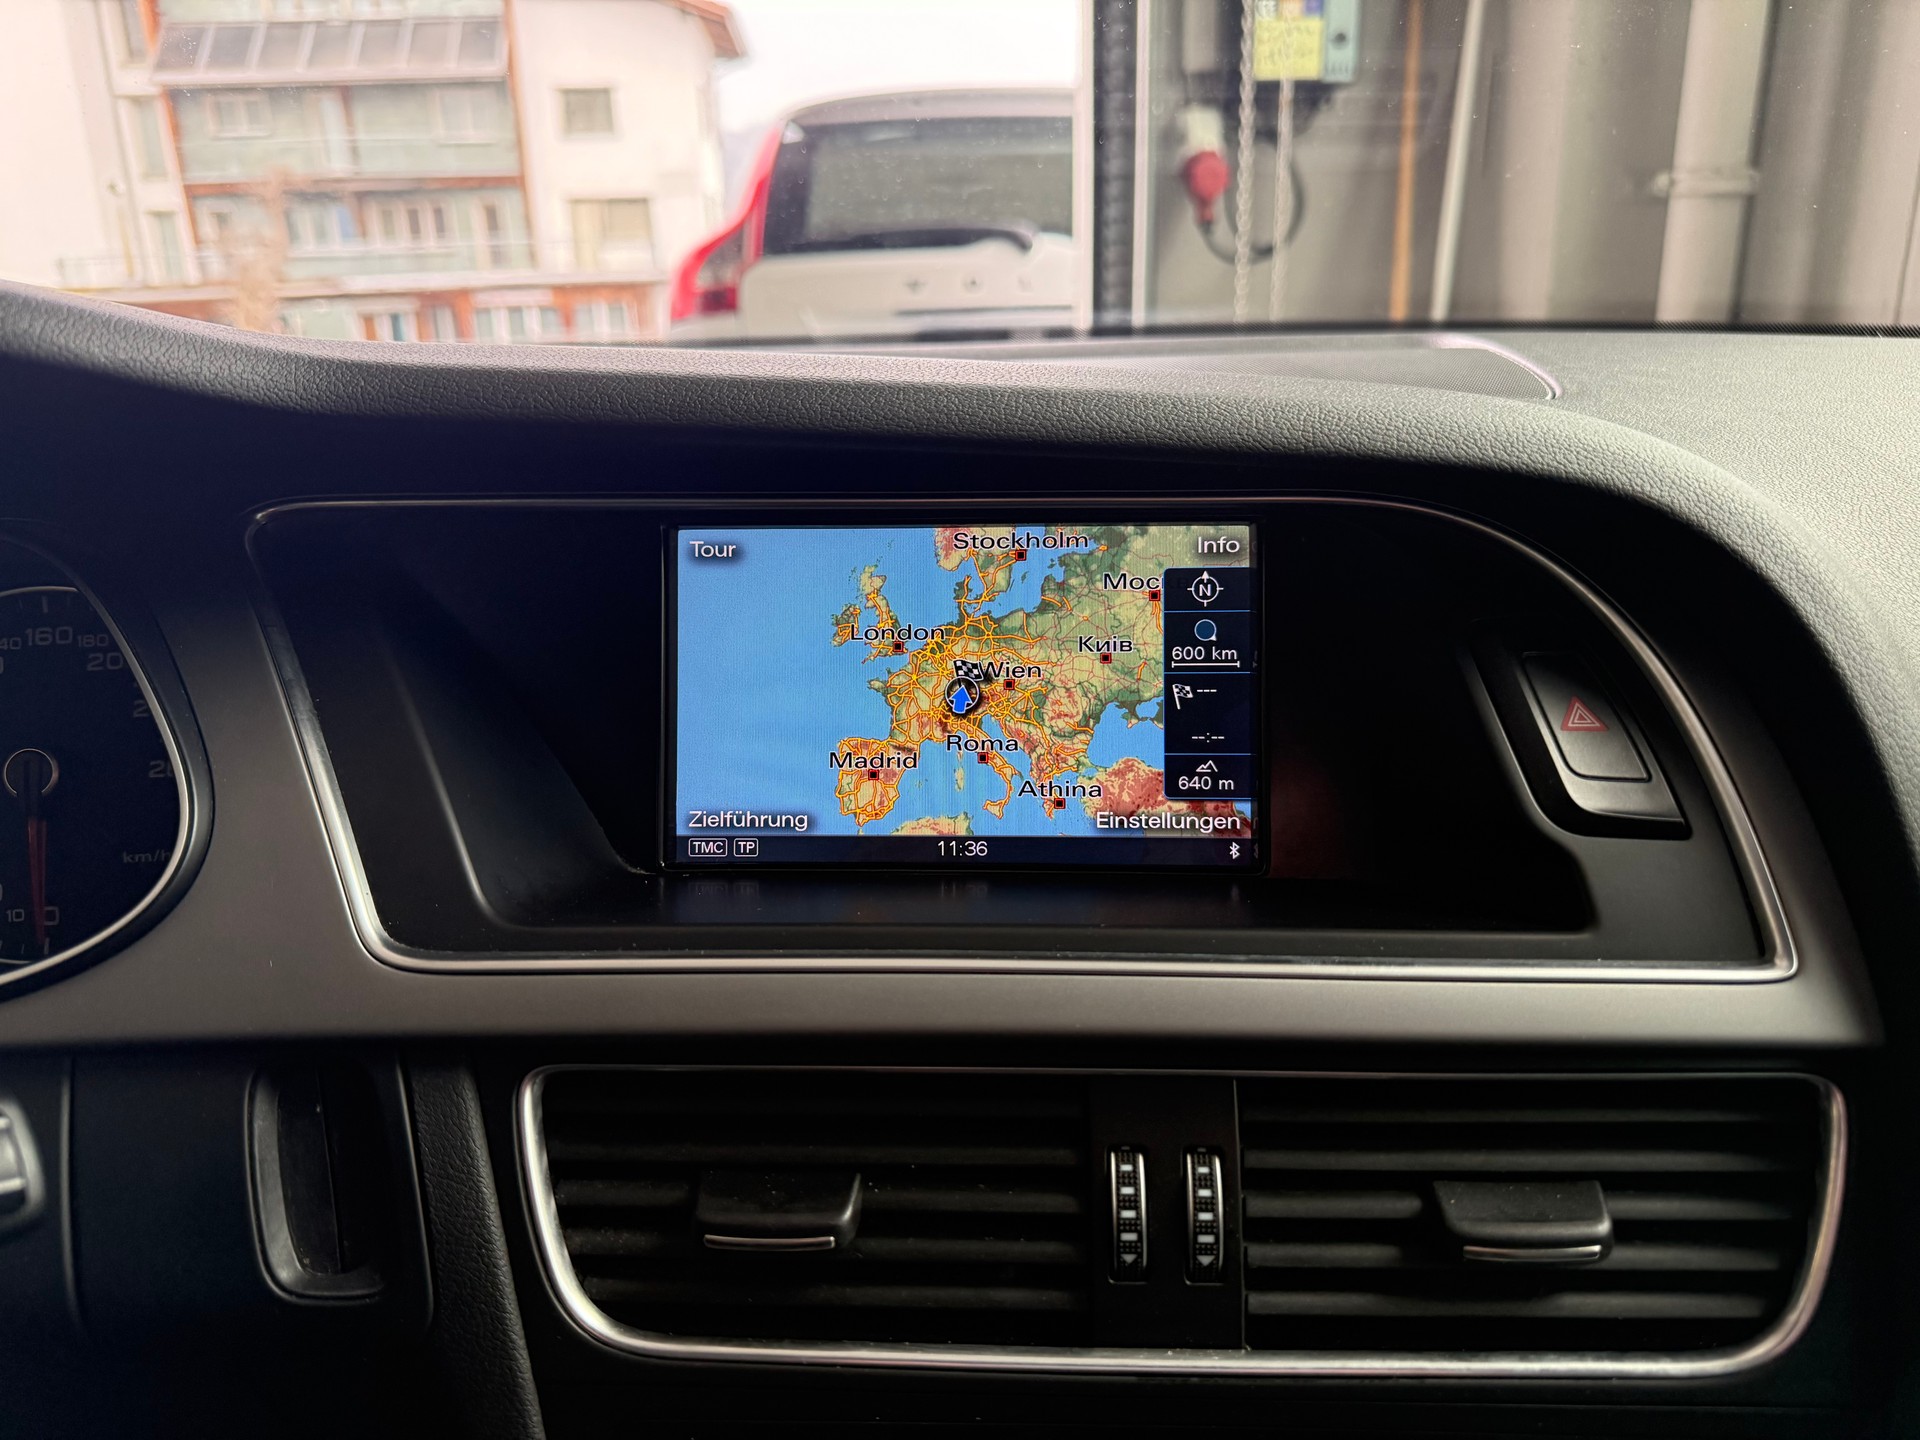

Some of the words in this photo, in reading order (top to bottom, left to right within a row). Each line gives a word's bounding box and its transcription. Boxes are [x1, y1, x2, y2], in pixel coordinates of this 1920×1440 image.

[953, 532, 1089, 549] Stockholm
[1197, 536, 1240, 553] Info
[689, 541, 736, 558] Tour
[1103, 573, 1164, 590] Мос
[1199, 584, 1211, 597] N
[25, 626, 73, 646] 160
[78, 634, 109, 648] 180
[851, 624, 945, 641] London
[0, 637, 21, 650] 40
[1078, 636, 1133, 653] Київ
[87, 652, 124, 671] 20
[1172, 646, 1205, 660] 600
[1212, 646, 1237, 660] km
[980, 662, 1041, 678] Wien
[946, 735, 1018, 752] Roma
[829, 752, 917, 769] Madrid
[1018, 781, 1102, 798] Athina
[1178, 776, 1211, 790] 640
[1219, 779, 1234, 790] m
[688, 811, 808, 831] Zielführung
[1096, 811, 1240, 833] Einstellungen
[693, 841, 724, 854] TMC
[738, 841, 755, 854] TP
[938, 841, 988, 856] 11:36
[123, 849, 171, 864] km/h
[6, 909, 25, 923] 10
